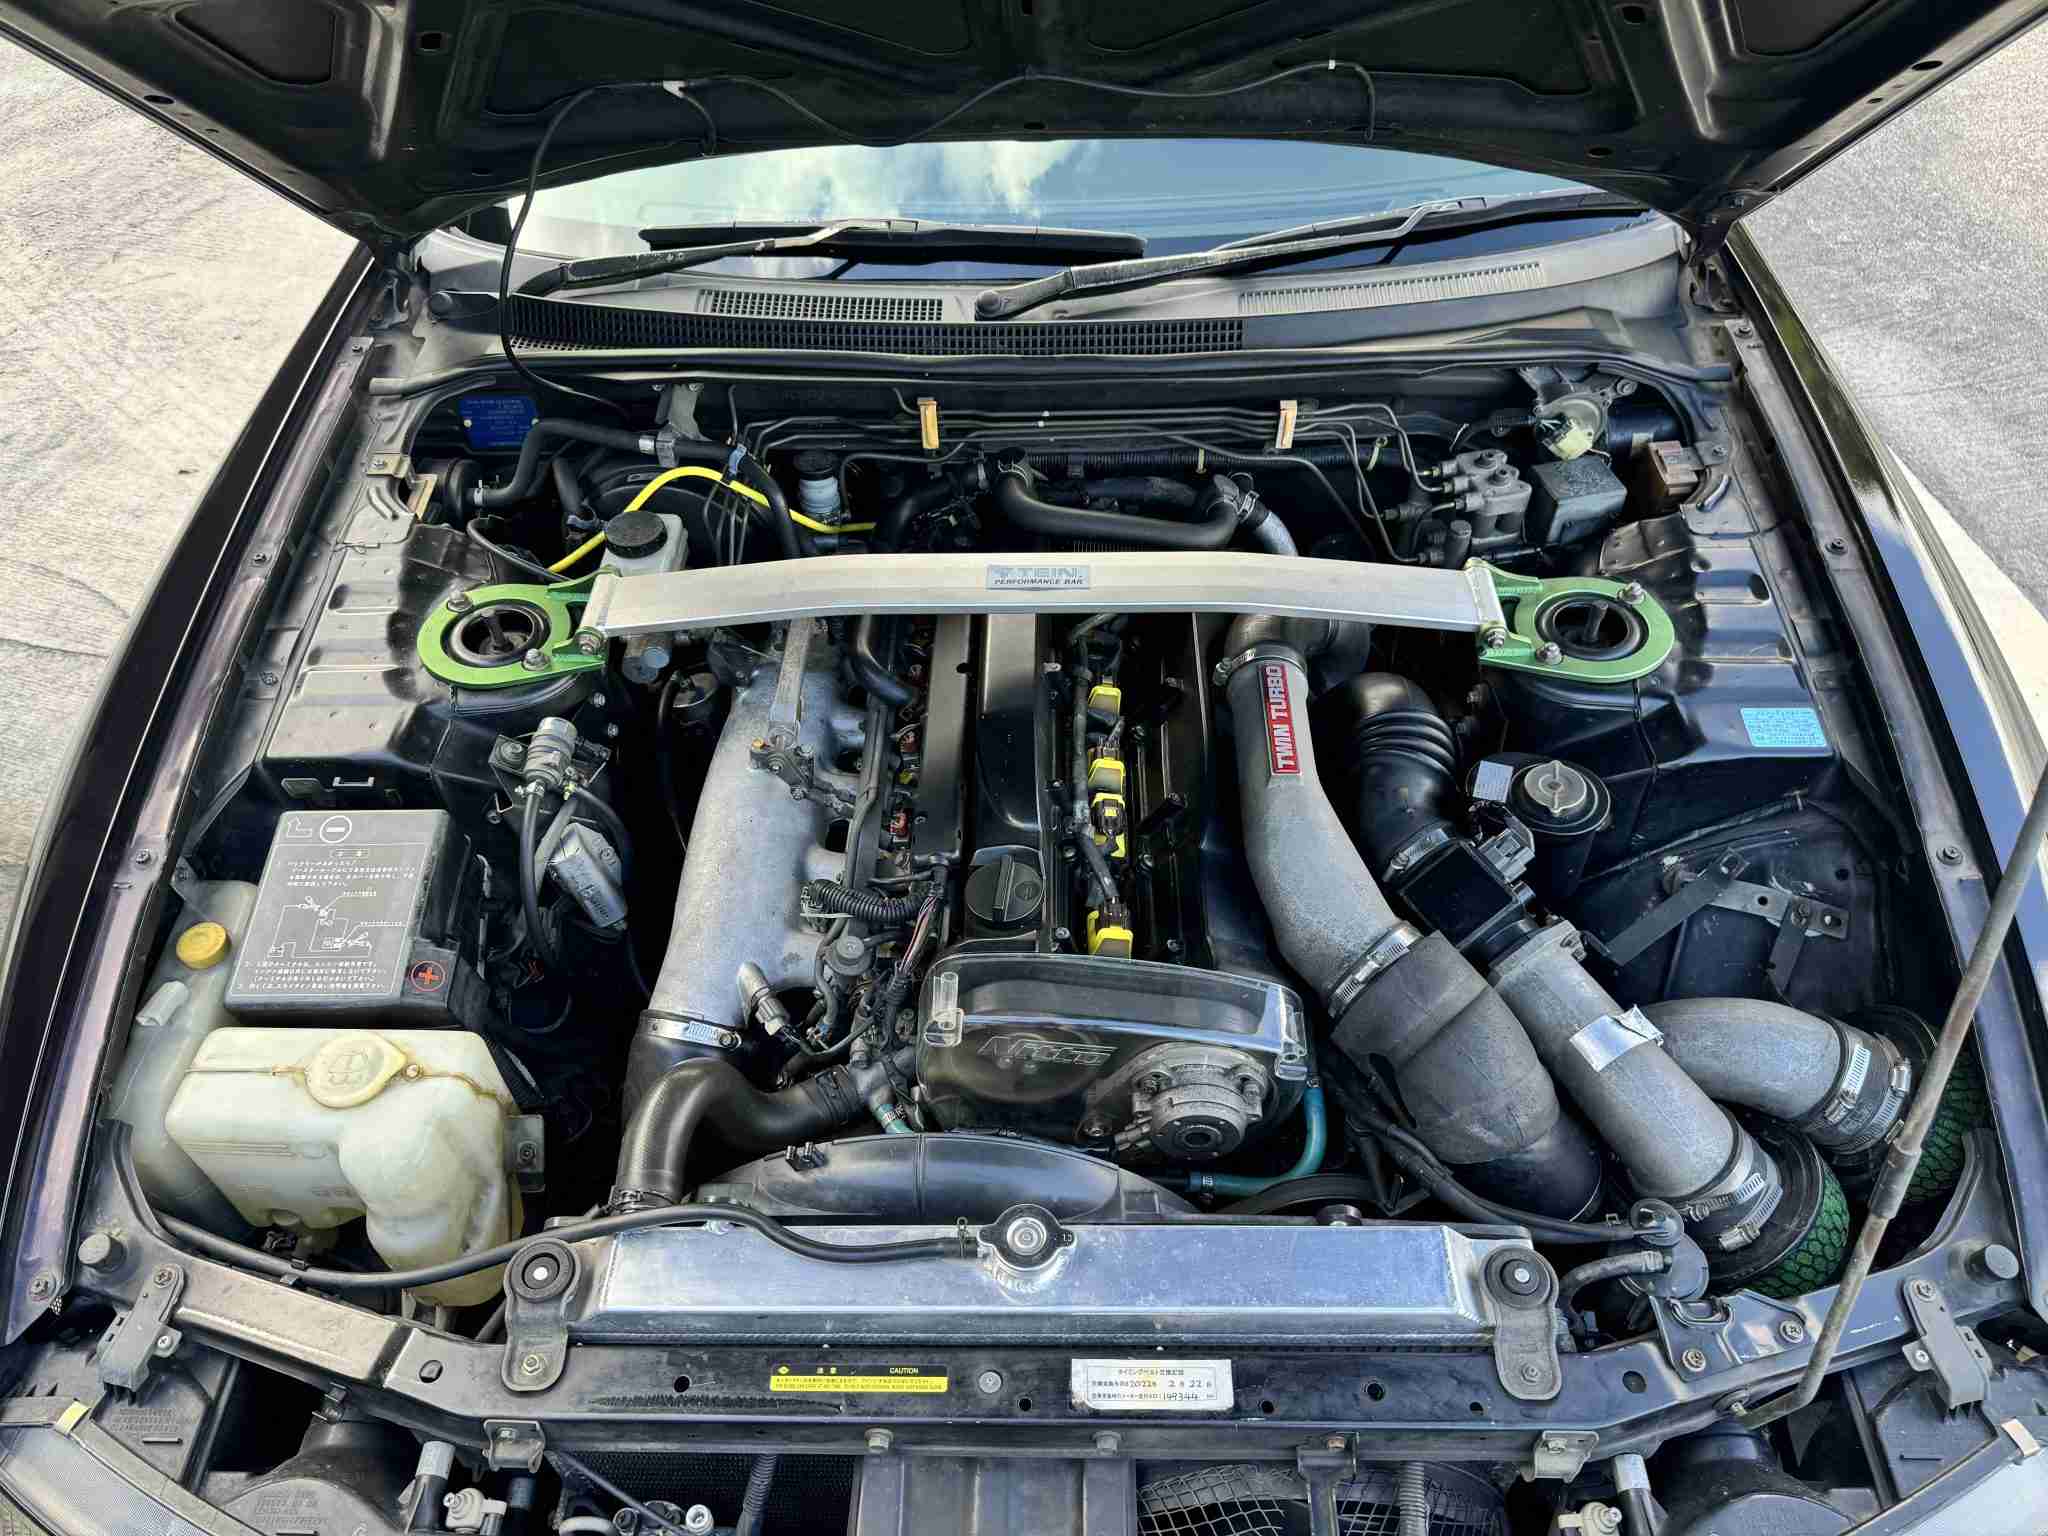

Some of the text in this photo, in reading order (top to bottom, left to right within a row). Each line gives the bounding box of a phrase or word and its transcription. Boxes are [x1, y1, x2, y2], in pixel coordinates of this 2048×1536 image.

[1266, 666, 1295, 768] TWIN TURBO
[889, 1367, 919, 1375] CAUTION
